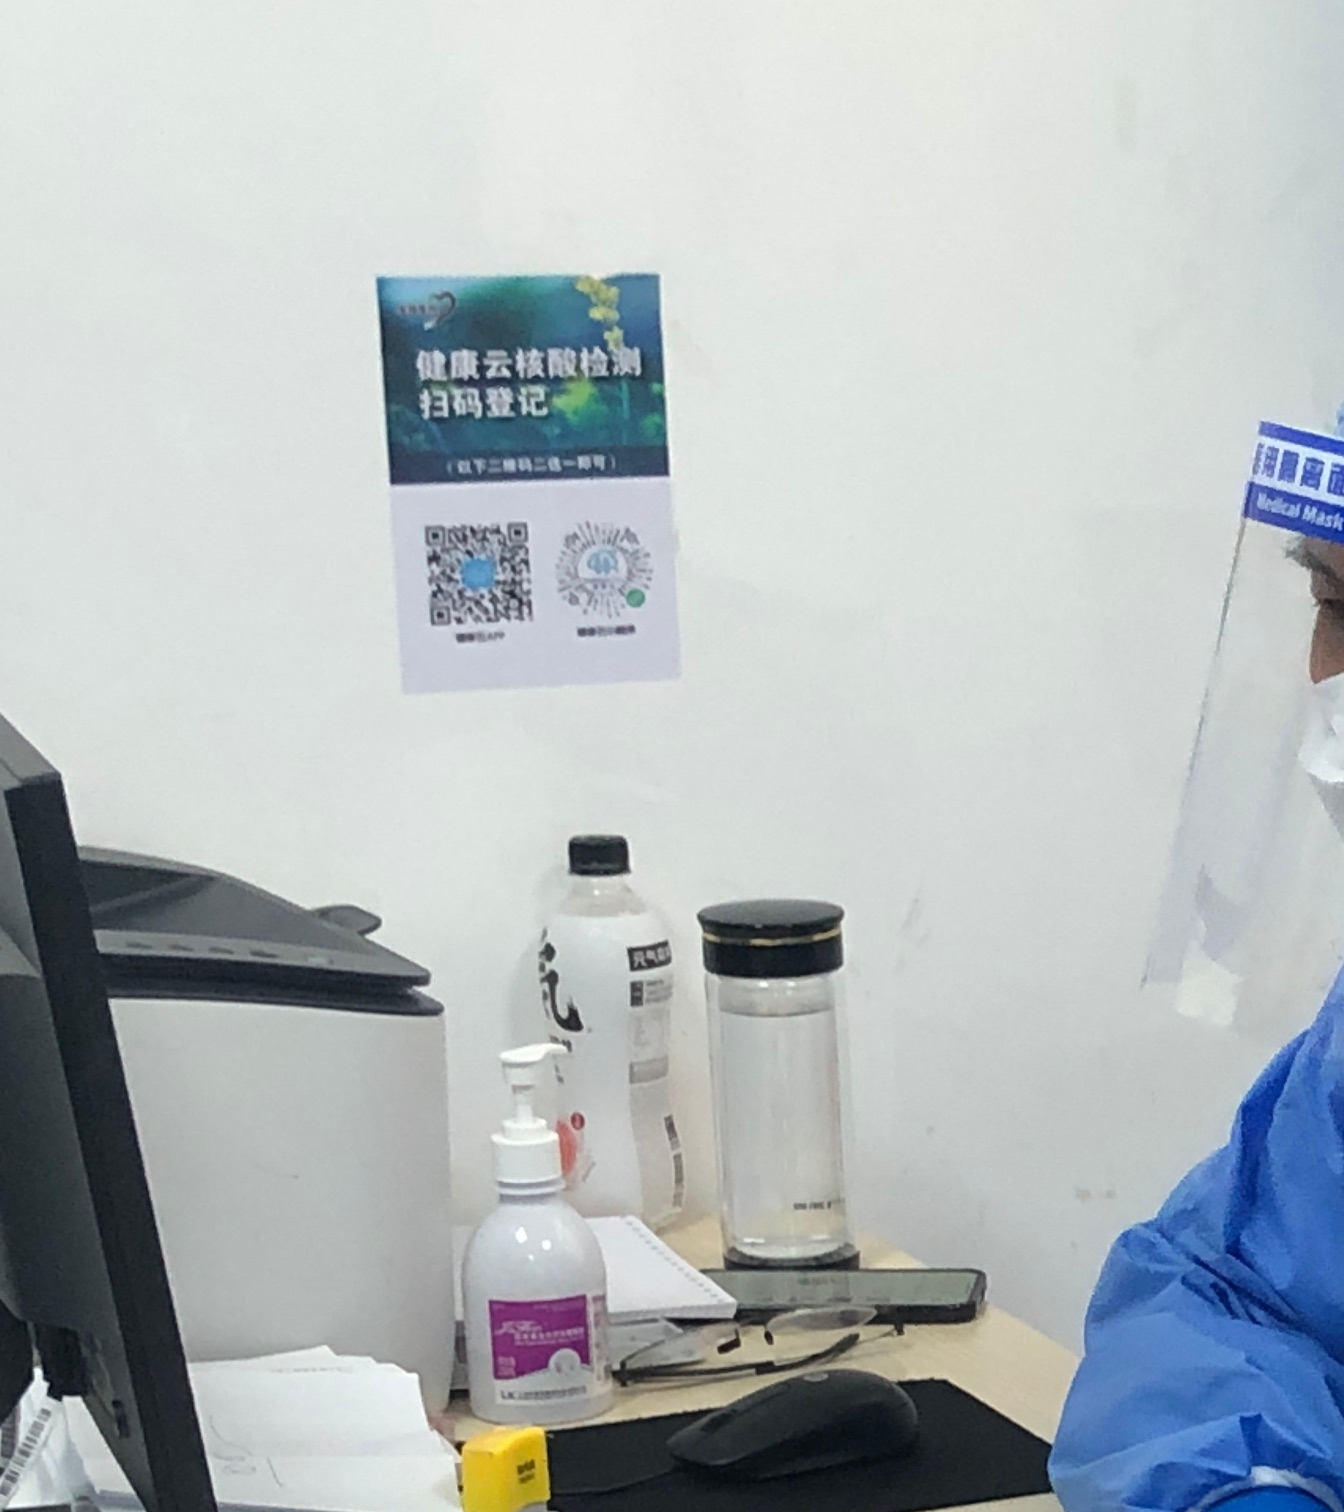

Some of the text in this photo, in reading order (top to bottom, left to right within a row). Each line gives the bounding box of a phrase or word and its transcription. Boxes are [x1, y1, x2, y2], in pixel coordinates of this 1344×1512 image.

[416, 345, 642, 381] 健康云核酸检测
[419, 382, 549, 420] 扫码登记
[1302, 504, 1344, 532] Mask
